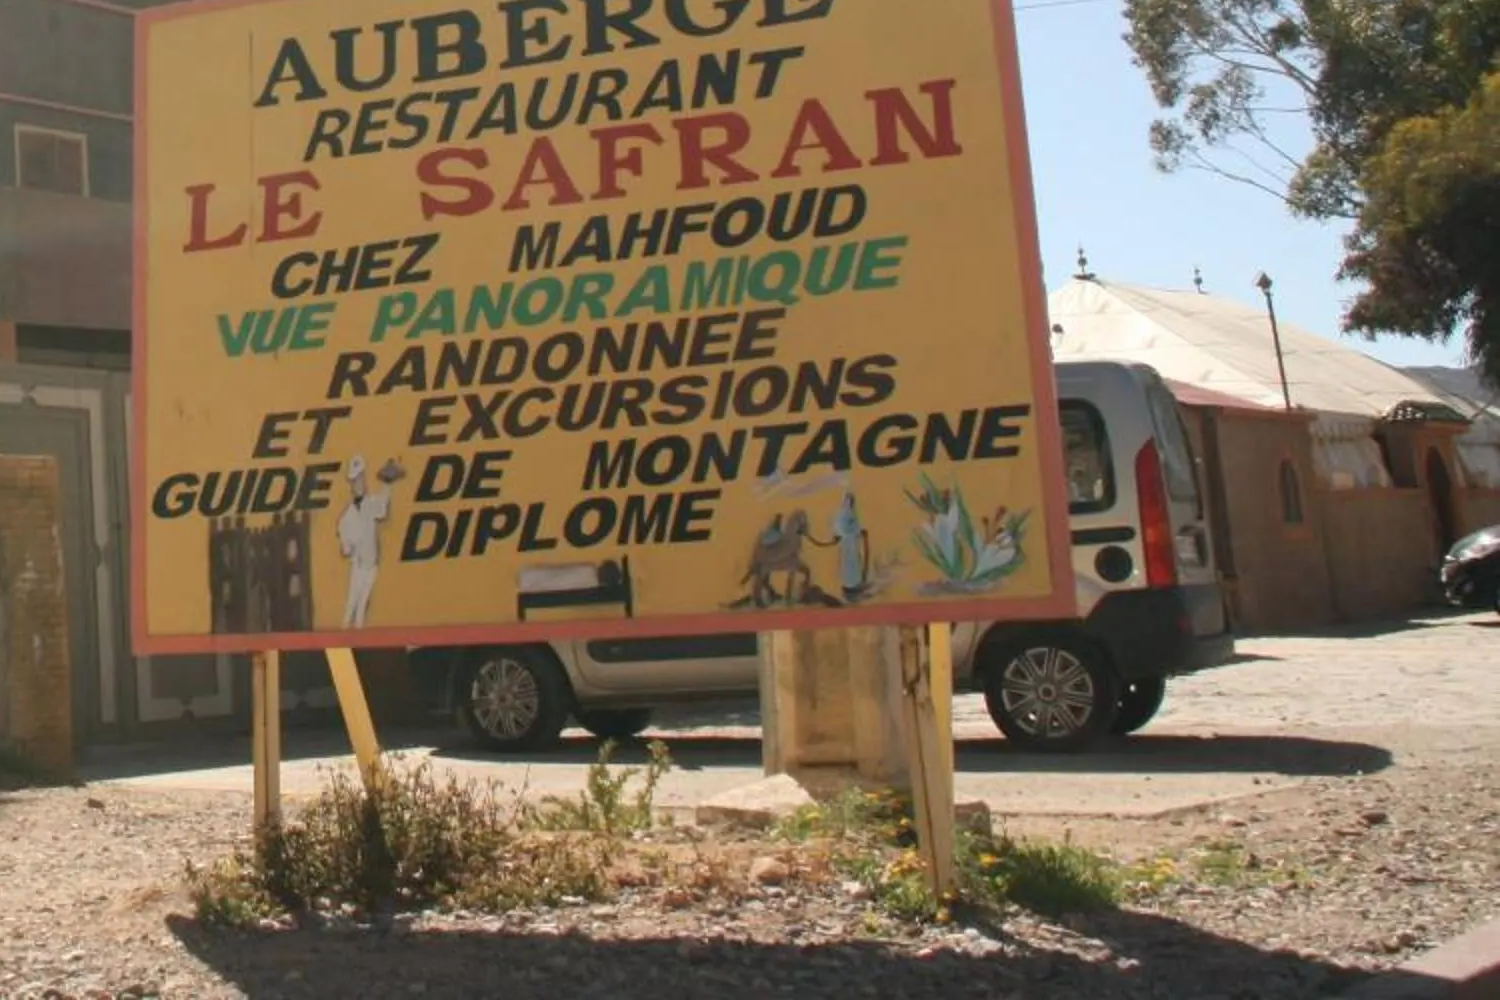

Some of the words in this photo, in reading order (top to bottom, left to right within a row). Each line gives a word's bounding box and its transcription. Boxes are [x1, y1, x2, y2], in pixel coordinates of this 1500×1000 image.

[303, 46, 805, 162] RESTAURANT
[183, 170, 324, 252] LE
[416, 78, 963, 221] SAFRAN
[217, 302, 337, 357] VUE
[370, 236, 908, 343] PANORAMIQUE
[271, 233, 440, 299] CHEZ
[508, 183, 868, 273] MAHFOUD
[251, 406, 352, 459] ET
[407, 353, 897, 447] EXCURSIONS
[326, 307, 787, 399] RANDONNEE
[151, 462, 341, 519] GUIDE
[414, 450, 513, 502] DE
[581, 404, 1031, 491] MONTAGNE
[400, 489, 722, 563] DIPLOME
